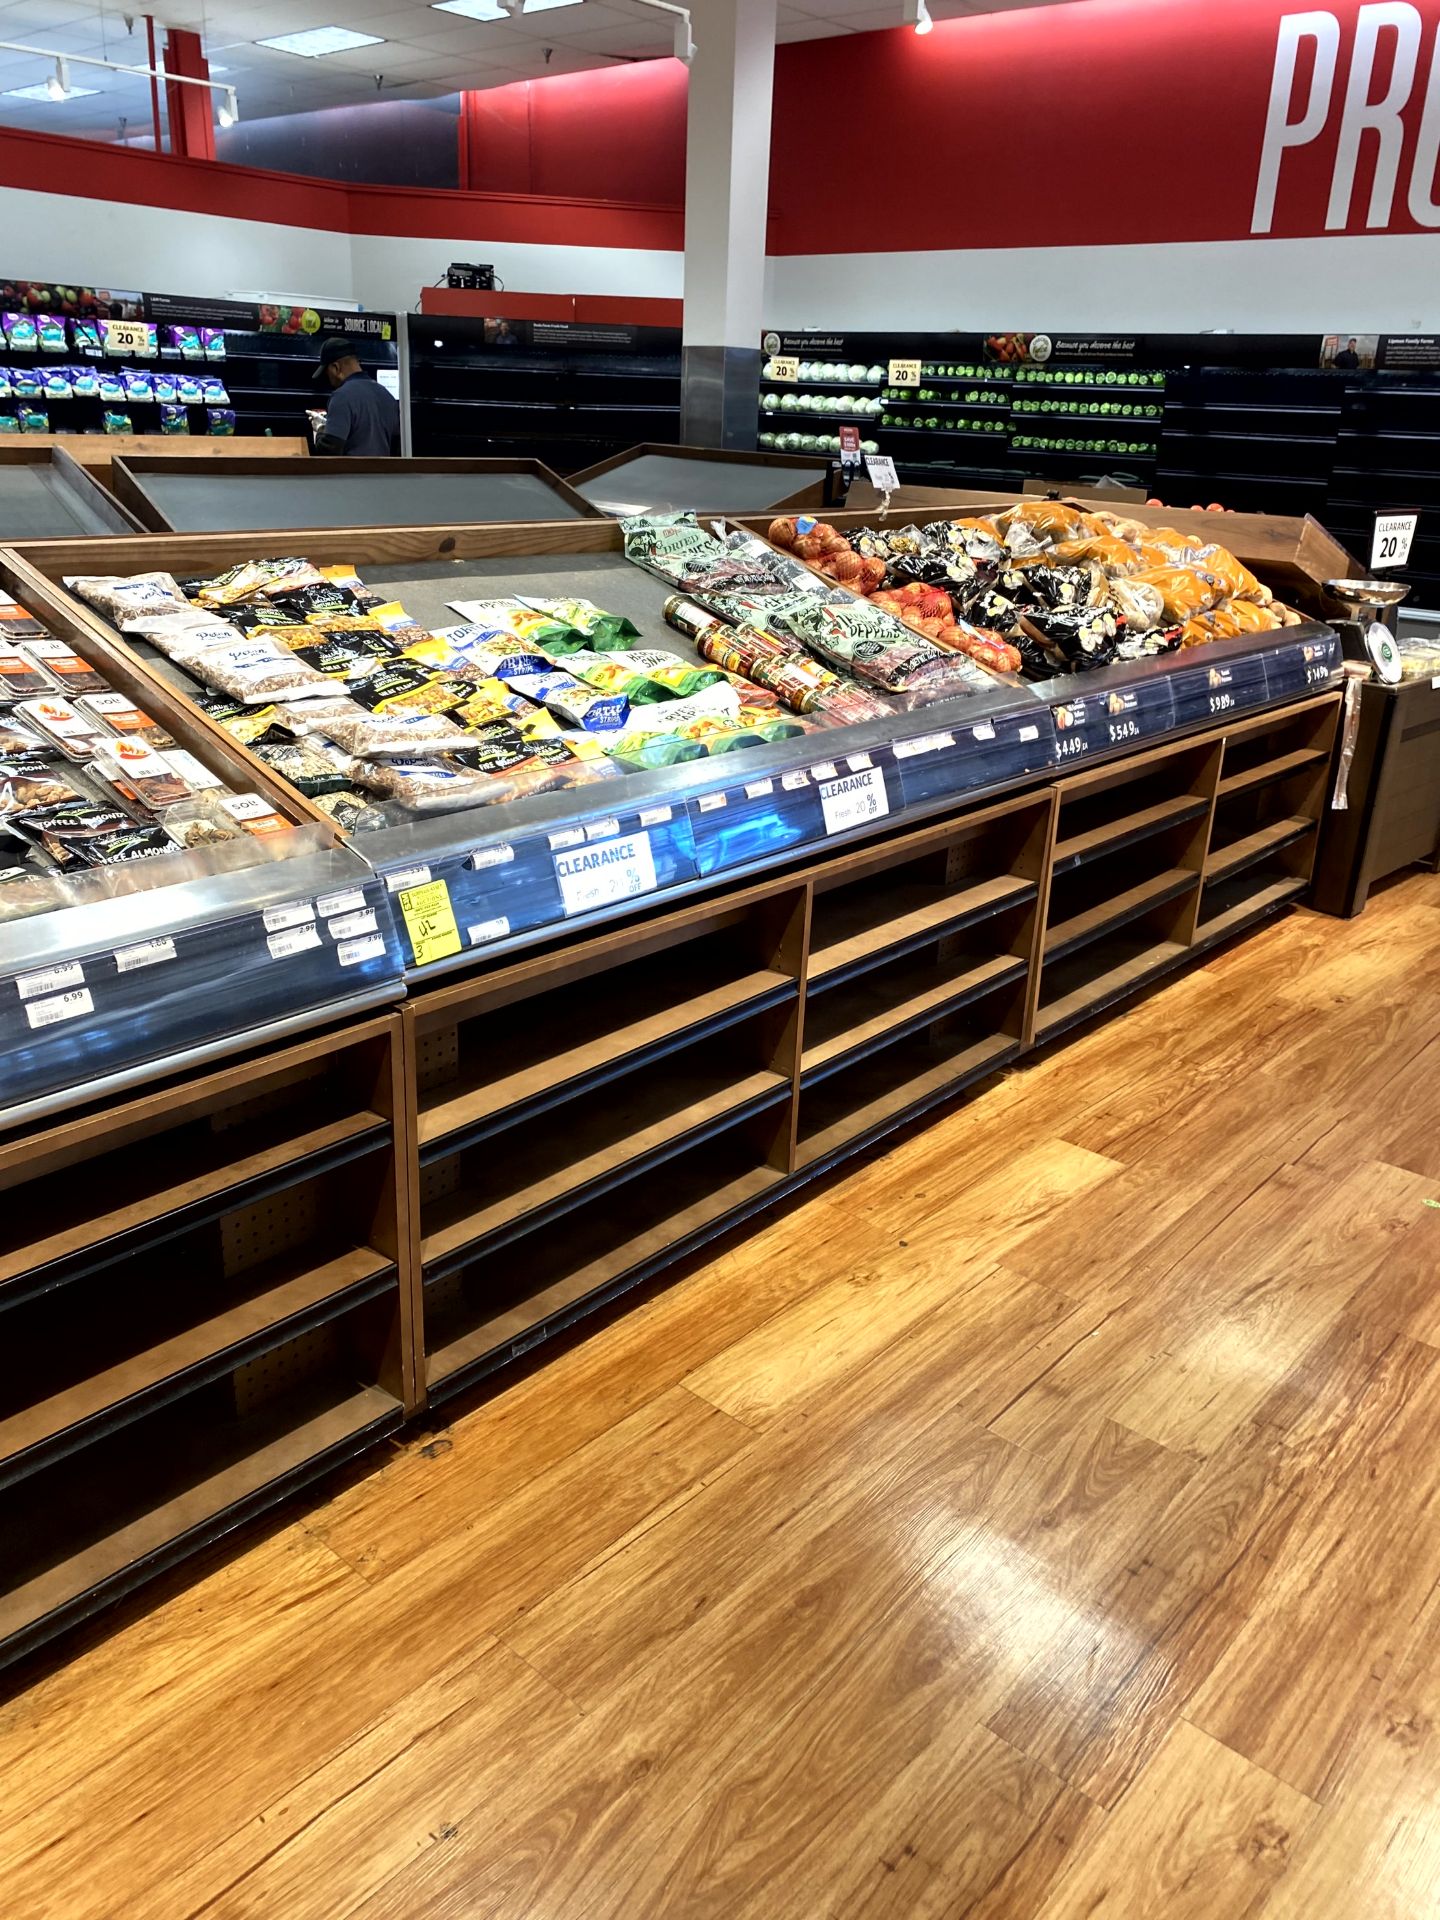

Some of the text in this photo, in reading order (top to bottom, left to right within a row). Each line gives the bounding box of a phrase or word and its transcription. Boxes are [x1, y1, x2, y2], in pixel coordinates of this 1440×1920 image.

[344, 318, 365, 332] SOURCE
[117, 332, 134, 344] 20
[1056, 340, 1135, 352] Because you deserve the best
[776, 366, 787, 376] 20
[895, 370, 908, 380] 20
[866, 457, 889, 466] CLEARANCE
[1379, 521, 1412, 532] CLEARANCE
[663, 534, 699, 554] DRIED
[1380, 537, 1408, 558] 20 %
[478, 762, 496, 771] FIRE
[821, 774, 873, 800] CLEARANCE
[835, 793, 877, 819] Fresh 20 %
[869, 806, 878, 815] OFF
[557, 843, 636, 878] CLEARANCE
[626, 867, 640, 883] %
[629, 882, 641, 892] OFF
[359, 908, 374, 918] 3.99
[299, 924, 315, 934] 2.99
[368, 934, 382, 943] 3.99
[416, 945, 423, 959] 3
[64, 991, 83, 1002] 6.99
